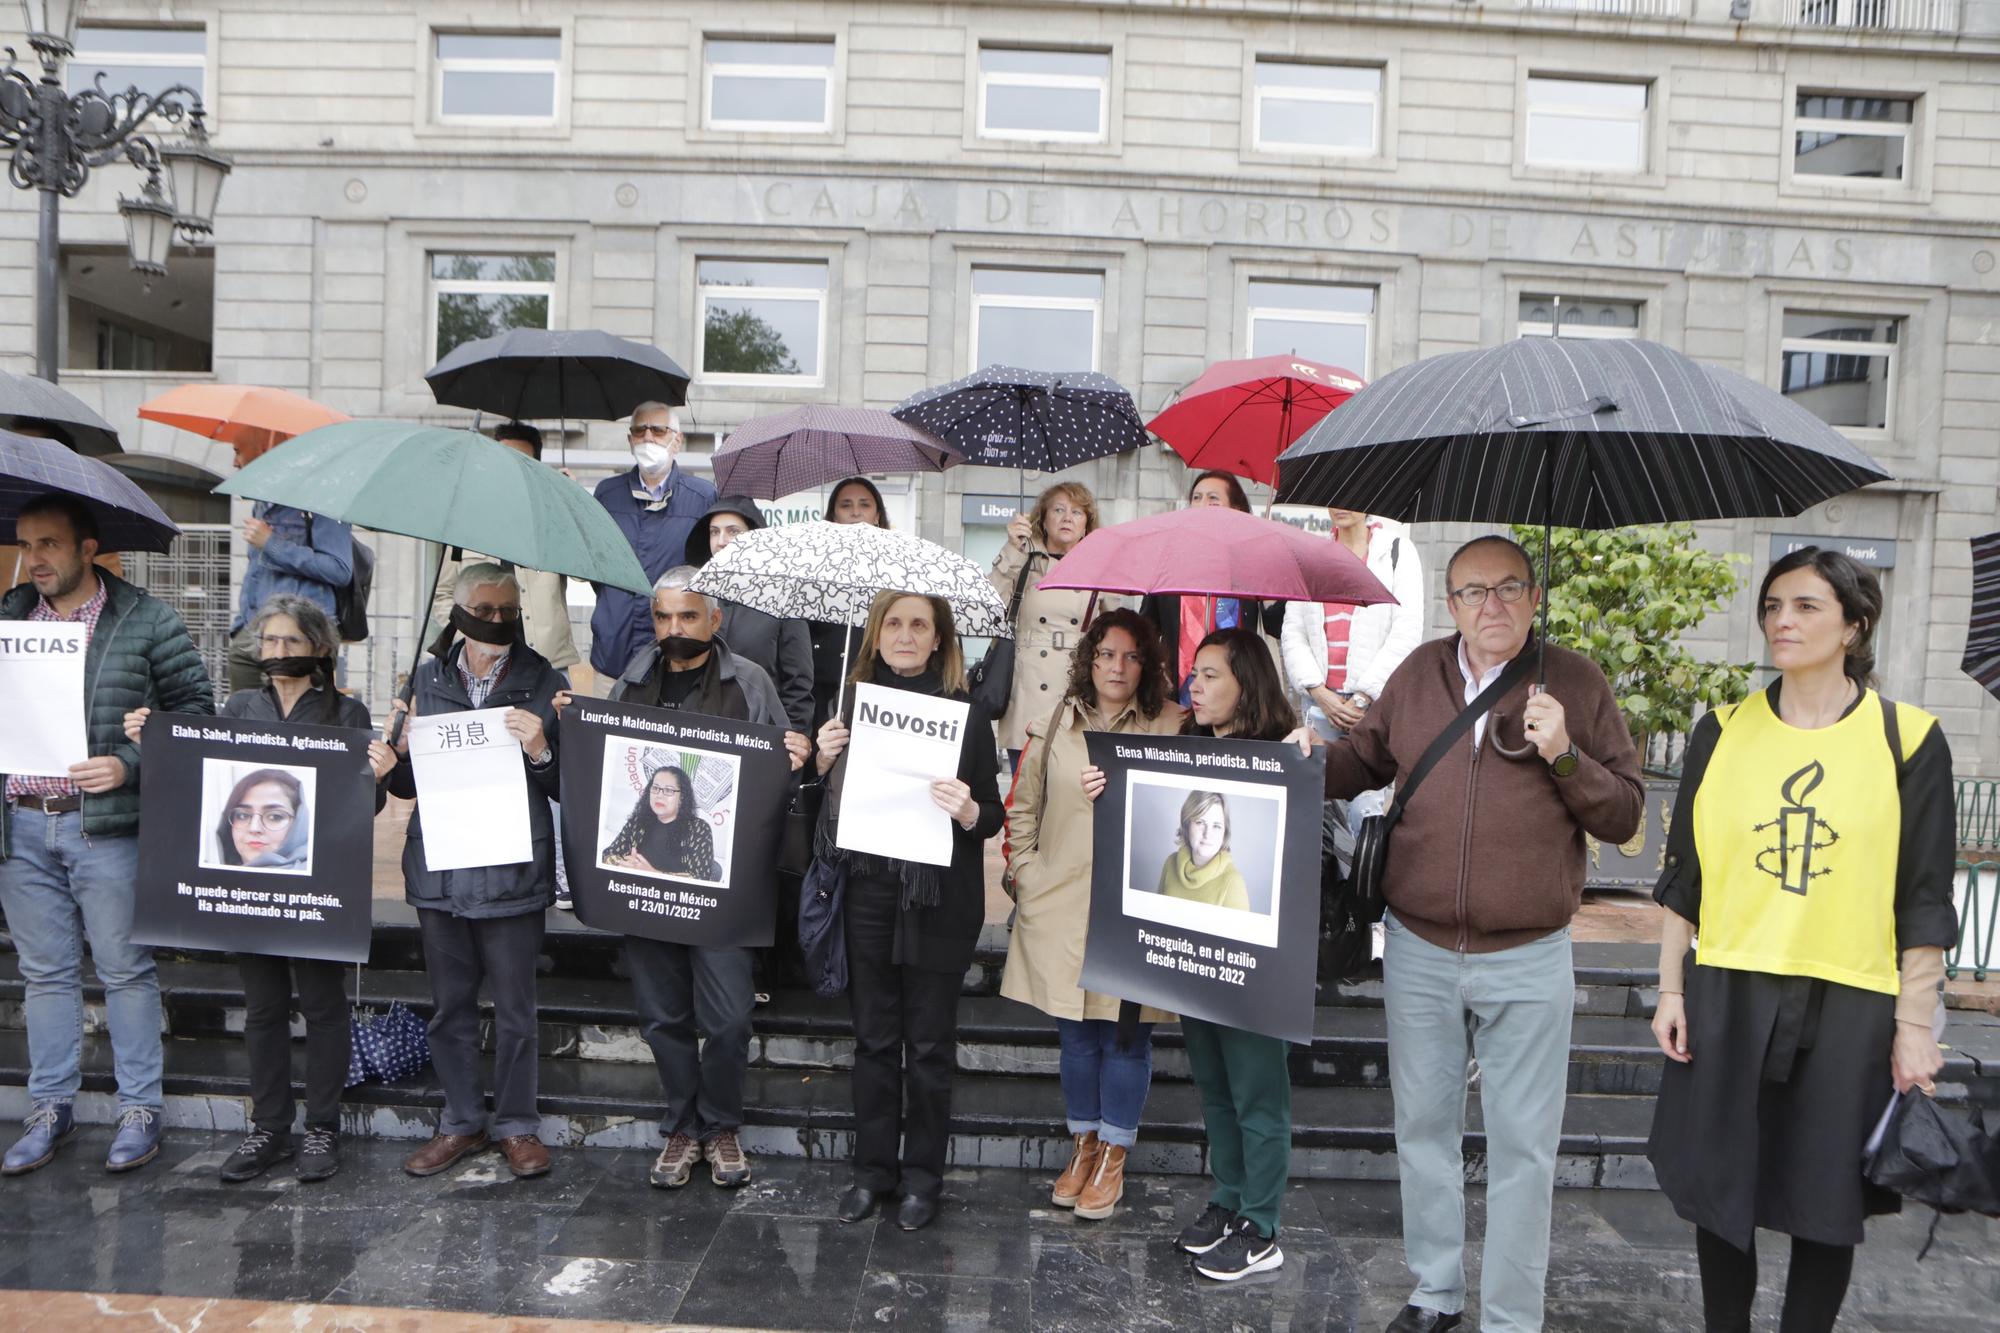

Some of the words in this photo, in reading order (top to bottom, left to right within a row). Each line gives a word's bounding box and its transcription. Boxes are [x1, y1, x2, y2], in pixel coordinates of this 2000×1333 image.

[763, 181, 925, 221] CAJA
[986, 188, 1049, 226] DE
[1111, 196, 1391, 244] AHORROS
[1448, 212, 1512, 250] DE
[760, 508, 784, 528] OS
[437, 721, 489, 749] 消息
[580, 709, 620, 726] Lourdes
[622, 715, 678, 737] Maldonado,
[680, 727, 733, 744] periodista.
[735, 733, 773, 751] México.
[859, 702, 959, 742] Novosti
[172, 725, 200, 739] Elaha
[202, 728, 233, 743] Sahel,
[235, 731, 289, 747] periodista.
[291, 735, 349, 752] Agfanistán.
[1115, 745, 1143, 759] Elena
[1144, 747, 1194, 766] Milashina,
[1195, 753, 1250, 770] periodista.
[1252, 756, 1284, 773] Rusia.
[177, 882, 192, 895] No
[195, 885, 228, 899] puede
[230, 888, 270, 902] ejercer
[273, 893, 286, 903] su
[288, 893, 343, 908] profesión.
[608, 879, 660, 899] Asesinada
[663, 891, 677, 902] en
[679, 891, 717, 908] México
[198, 899, 213, 912] Ha
[215, 901, 281, 918] abandonado
[284, 910, 297, 919] su
[299, 907, 325, 921] país.
[628, 899, 638, 910] el
[641, 900, 701, 920] 23/01/2022
[1138, 929, 1197, 957] Perseguida,
[1199, 945, 1212, 959] en
[1214, 947, 1225, 962] el
[1227, 951, 1256, 969] exilio
[1146, 949, 1176, 969] desde
[1178, 956, 1217, 979] febrero
[1218, 966, 1245, 986] 2022
